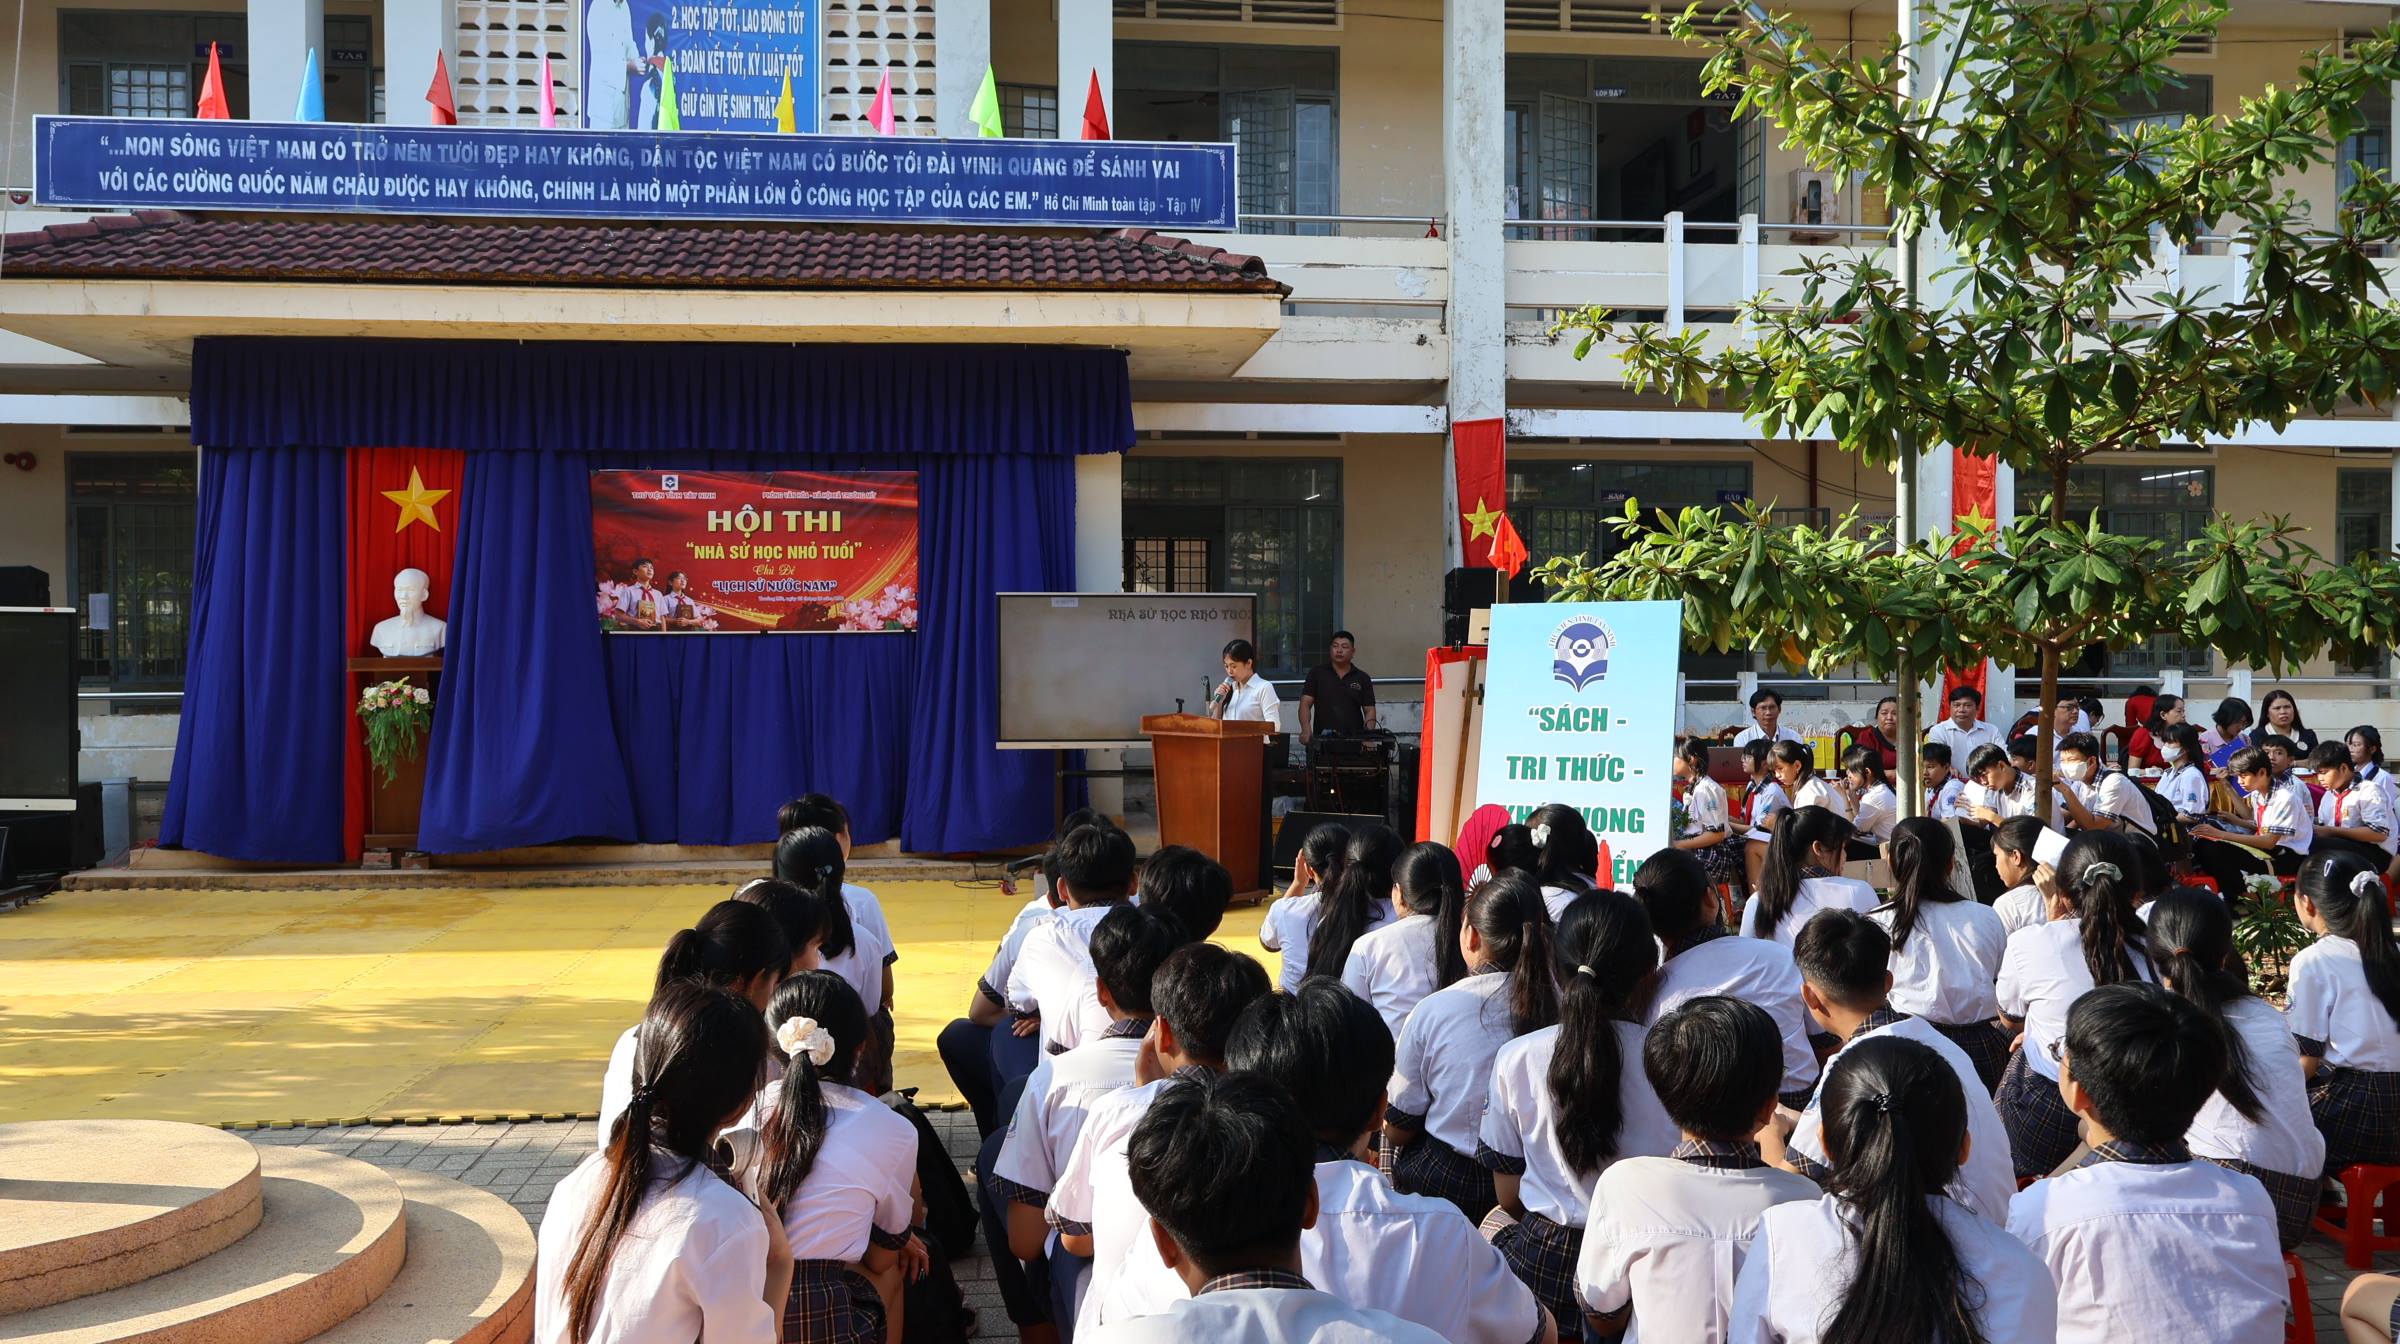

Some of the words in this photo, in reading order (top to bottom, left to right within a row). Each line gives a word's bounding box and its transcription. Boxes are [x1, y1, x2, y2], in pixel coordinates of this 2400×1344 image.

[672, 6, 679, 29] 2.
[682, 6, 700, 37] HỌC
[702, 1, 719, 37] TẬP
[720, 0, 740, 37] TỐT,
[742, 9, 759, 33] LAO
[761, 3, 785, 40] ĐỘNG
[788, 1, 805, 34] TỐT
[672, 49, 679, 73] 3.
[682, 43, 705, 74] ĐOÀN
[707, 41, 725, 75] KẾT
[727, 42, 746, 80] TỐT,
[748, 43, 760, 76] KỶ
[763, 47, 784, 83] LUẬT
[787, 44, 804, 78] TỐT
[681, 87, 698, 117] GIỮ
[699, 87, 715, 118] GÌN
[717, 88, 729, 125] VỆ
[731, 94, 751, 119] SINH
[753, 89, 776, 126] THẬT
[170, 132, 221, 158] SÔNG
[227, 134, 270, 163] VIỆT
[276, 140, 316, 160] NAM
[321, 136, 346, 161] CÓ
[351, 137, 389, 161] TRỞ
[394, 139, 432, 162] NÊN
[437, 140, 479, 164] TƯƠI
[484, 144, 520, 168] ĐẸP
[525, 146, 562, 165] HAY
[567, 143, 634, 170] KHÔNG,
[640, 144, 677, 169] DÂN
[684, 147, 718, 174] TỘC
[723, 147, 763, 174] VIỆT
[768, 151, 807, 172] NAM
[812, 148, 836, 173] CÓ
[841, 149, 888, 174] BƯỚC
[893, 149, 922, 174] TỚI
[926, 151, 956, 175] ĐÀI
[962, 155, 1002, 176] VINH
[1008, 156, 1067, 178] QUANG
[1072, 150, 1096, 178] ĐỂ
[1100, 154, 1147, 179] SÁNH
[1152, 159, 1180, 179] VAI
[98, 165, 128, 192] VỚI
[133, 167, 168, 193] CÁC
[173, 168, 233, 193] CƯỜNG
[238, 166, 286, 195] QUỐC
[290, 171, 328, 195] NĂM
[332, 173, 379, 197] CHÂU
[384, 174, 430, 202] ĐƯỢC
[435, 178, 470, 198] HAY
[474, 175, 539, 203] KHÔNG,
[543, 177, 595, 201] CHÍNH
[600, 177, 621, 201] LÀ
[626, 177, 660, 202] NHỜ
[665, 180, 700, 208] MỘT
[705, 177, 749, 205] PHẦN
[754, 179, 786, 205] LỚN
[791, 179, 802, 206] Ở
[806, 183, 851, 207] CÔNG
[856, 188, 889, 212] HỌC
[895, 187, 925, 212] TẬP
[930, 182, 963, 210] CỦA
[968, 185, 1000, 210] CÁC
[1044, 195, 1059, 210] Hồ
[1062, 195, 1079, 211] Chí
[1083, 196, 1109, 212] Minh
[1112, 197, 1135, 212] toàn
[1139, 197, 1156, 215] tập
[1166, 197, 1187, 216] Tập
[1191, 197, 1201, 213] IV
[707, 503, 773, 538] HỘI
[781, 510, 841, 533] THI
[686, 541, 725, 560] “NHÀ
[729, 540, 751, 560] SỬ
[754, 545, 783, 562] HỌC
[787, 541, 818, 560] NHỎ
[822, 540, 863, 560] TUỔI”
[748, 577, 766, 592] SỬ
[767, 577, 801, 592] NƯỚC
[1528, 703, 1608, 732] “SÁCH
[1506, 755, 1547, 780] TRI
[1556, 753, 1625, 782] THỨC
